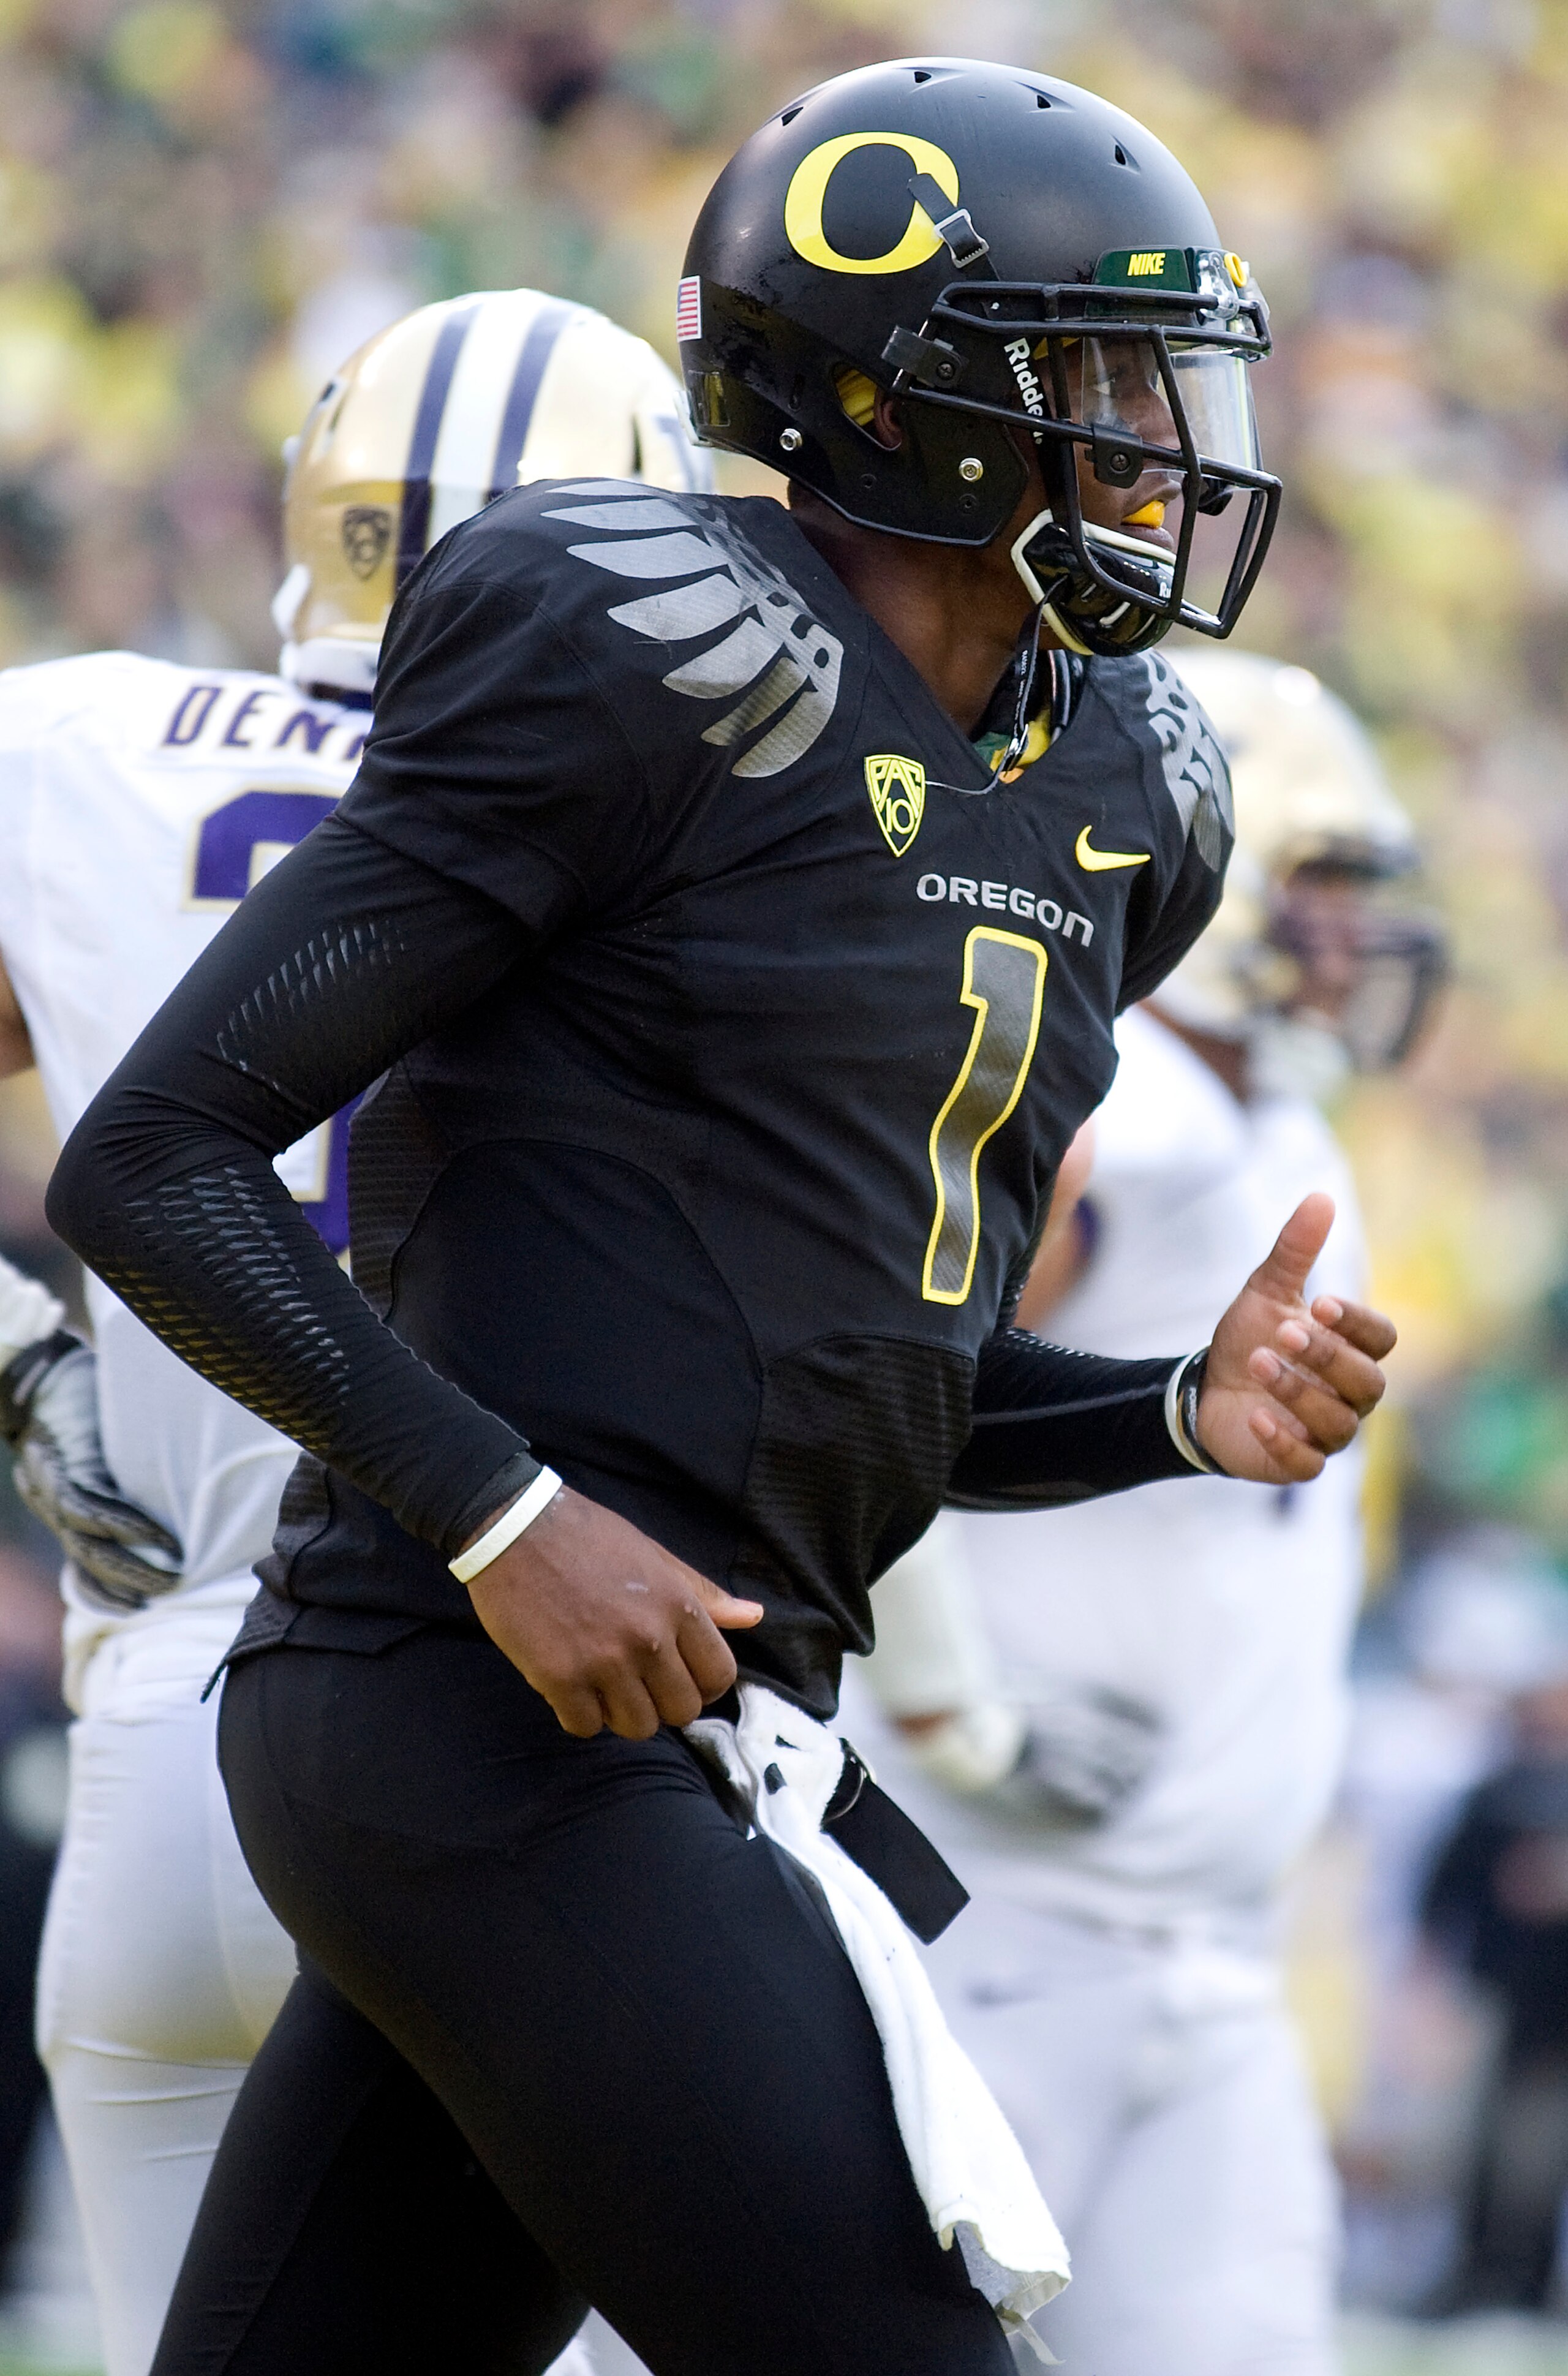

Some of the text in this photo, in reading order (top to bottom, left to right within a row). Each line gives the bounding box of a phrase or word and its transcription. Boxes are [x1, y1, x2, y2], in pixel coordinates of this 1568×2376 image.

[784, 131, 959, 274] O
[1127, 252, 1166, 276] NIKE
[869, 759, 921, 819] PAC
[886, 798, 915, 834] 10
[916, 873, 1094, 947] OREGON
[922, 925, 1048, 1306] 1
